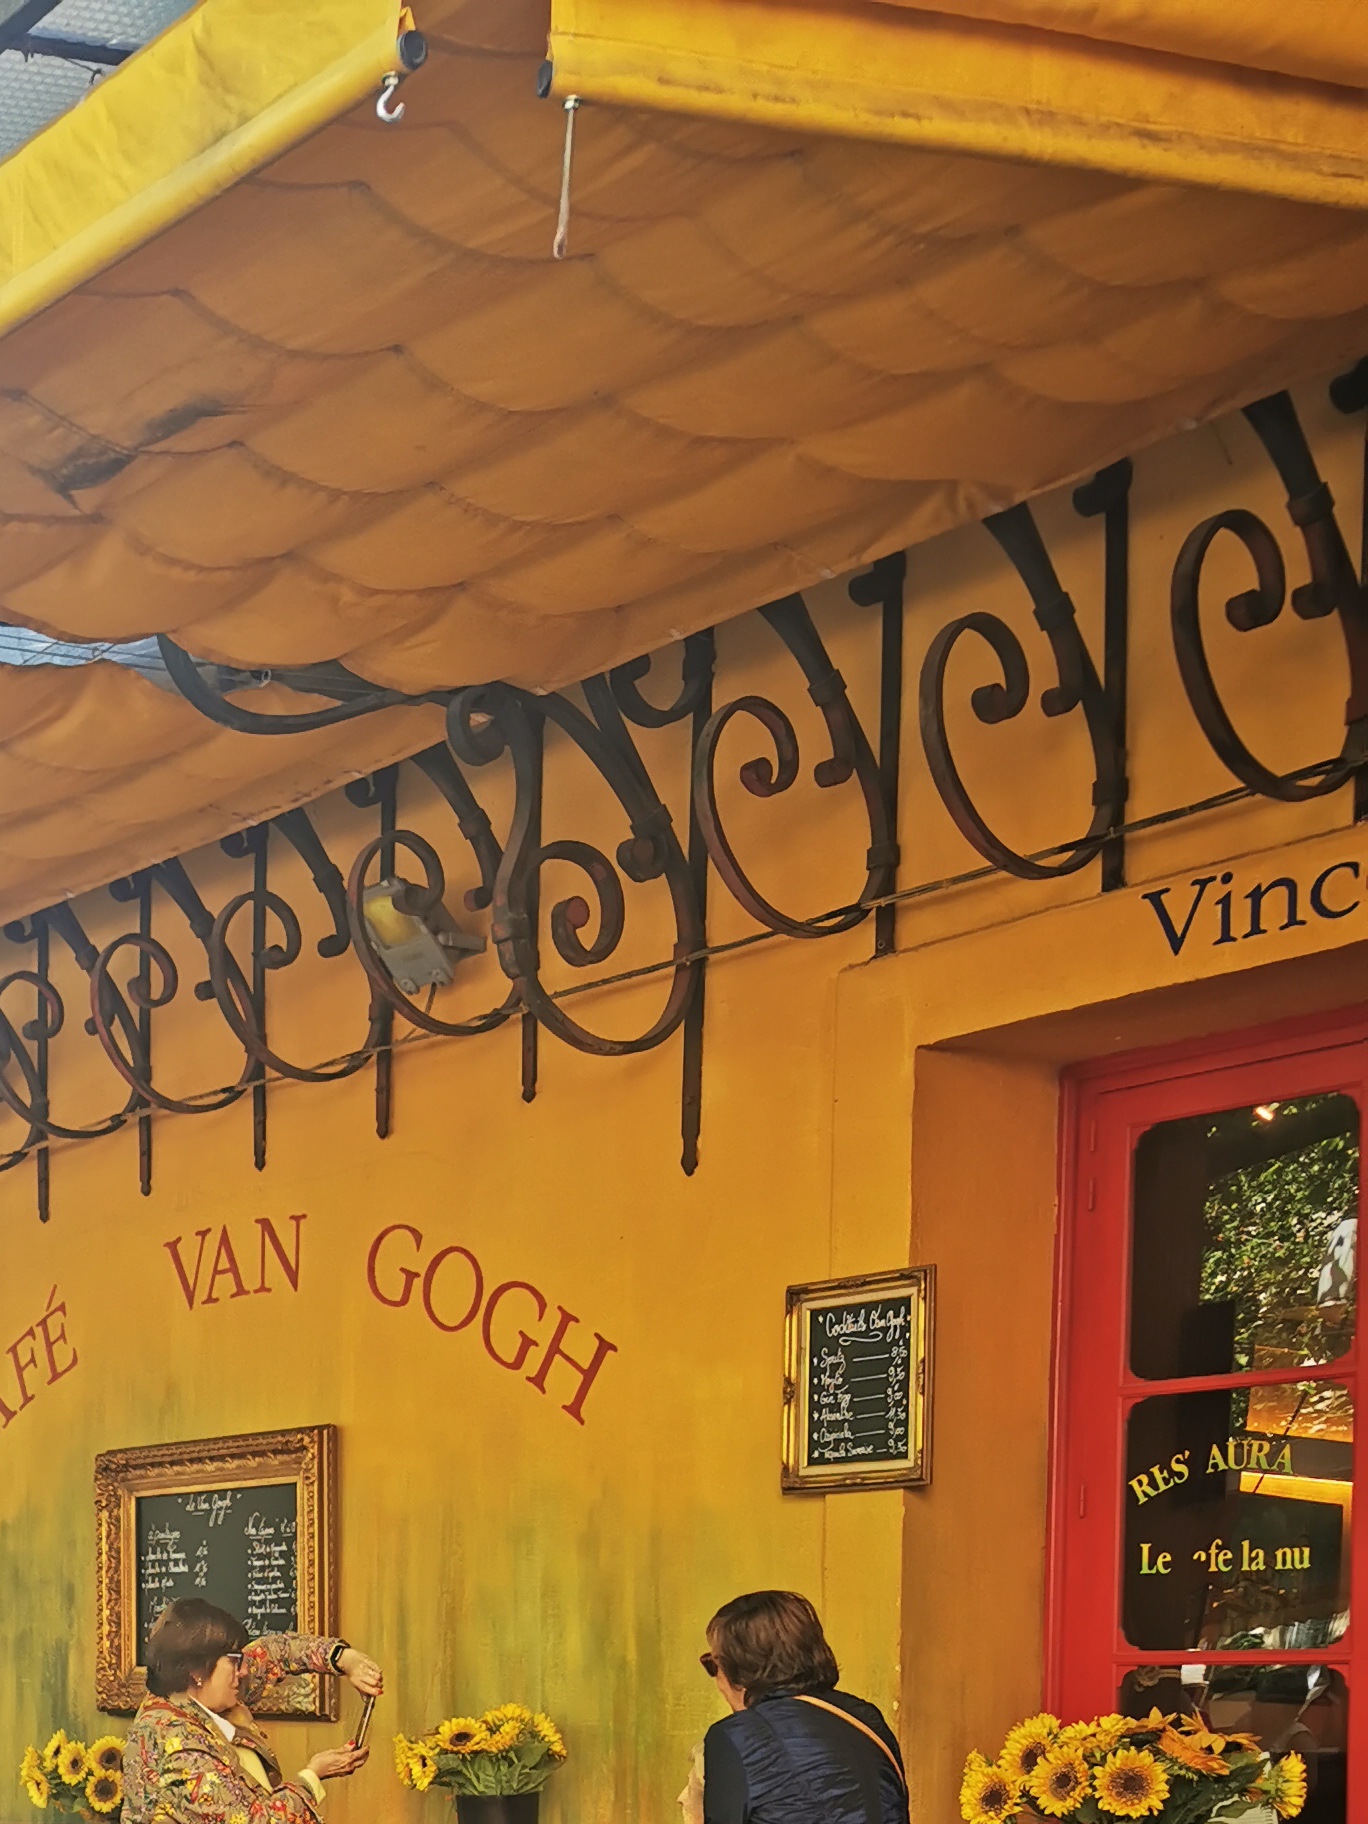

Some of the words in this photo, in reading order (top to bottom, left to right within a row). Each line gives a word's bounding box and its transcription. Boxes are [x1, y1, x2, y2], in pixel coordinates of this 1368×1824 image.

[1141, 861, 1360, 956] Vinc
[162, 1214, 307, 1311] VAN
[366, 1222, 618, 1427] GOGH
[1128, 1439, 1293, 1505] RESAURA
[1140, 1543, 1171, 1574] Le
[1241, 1540, 1265, 1571] la
[1275, 1546, 1311, 1570] nu
